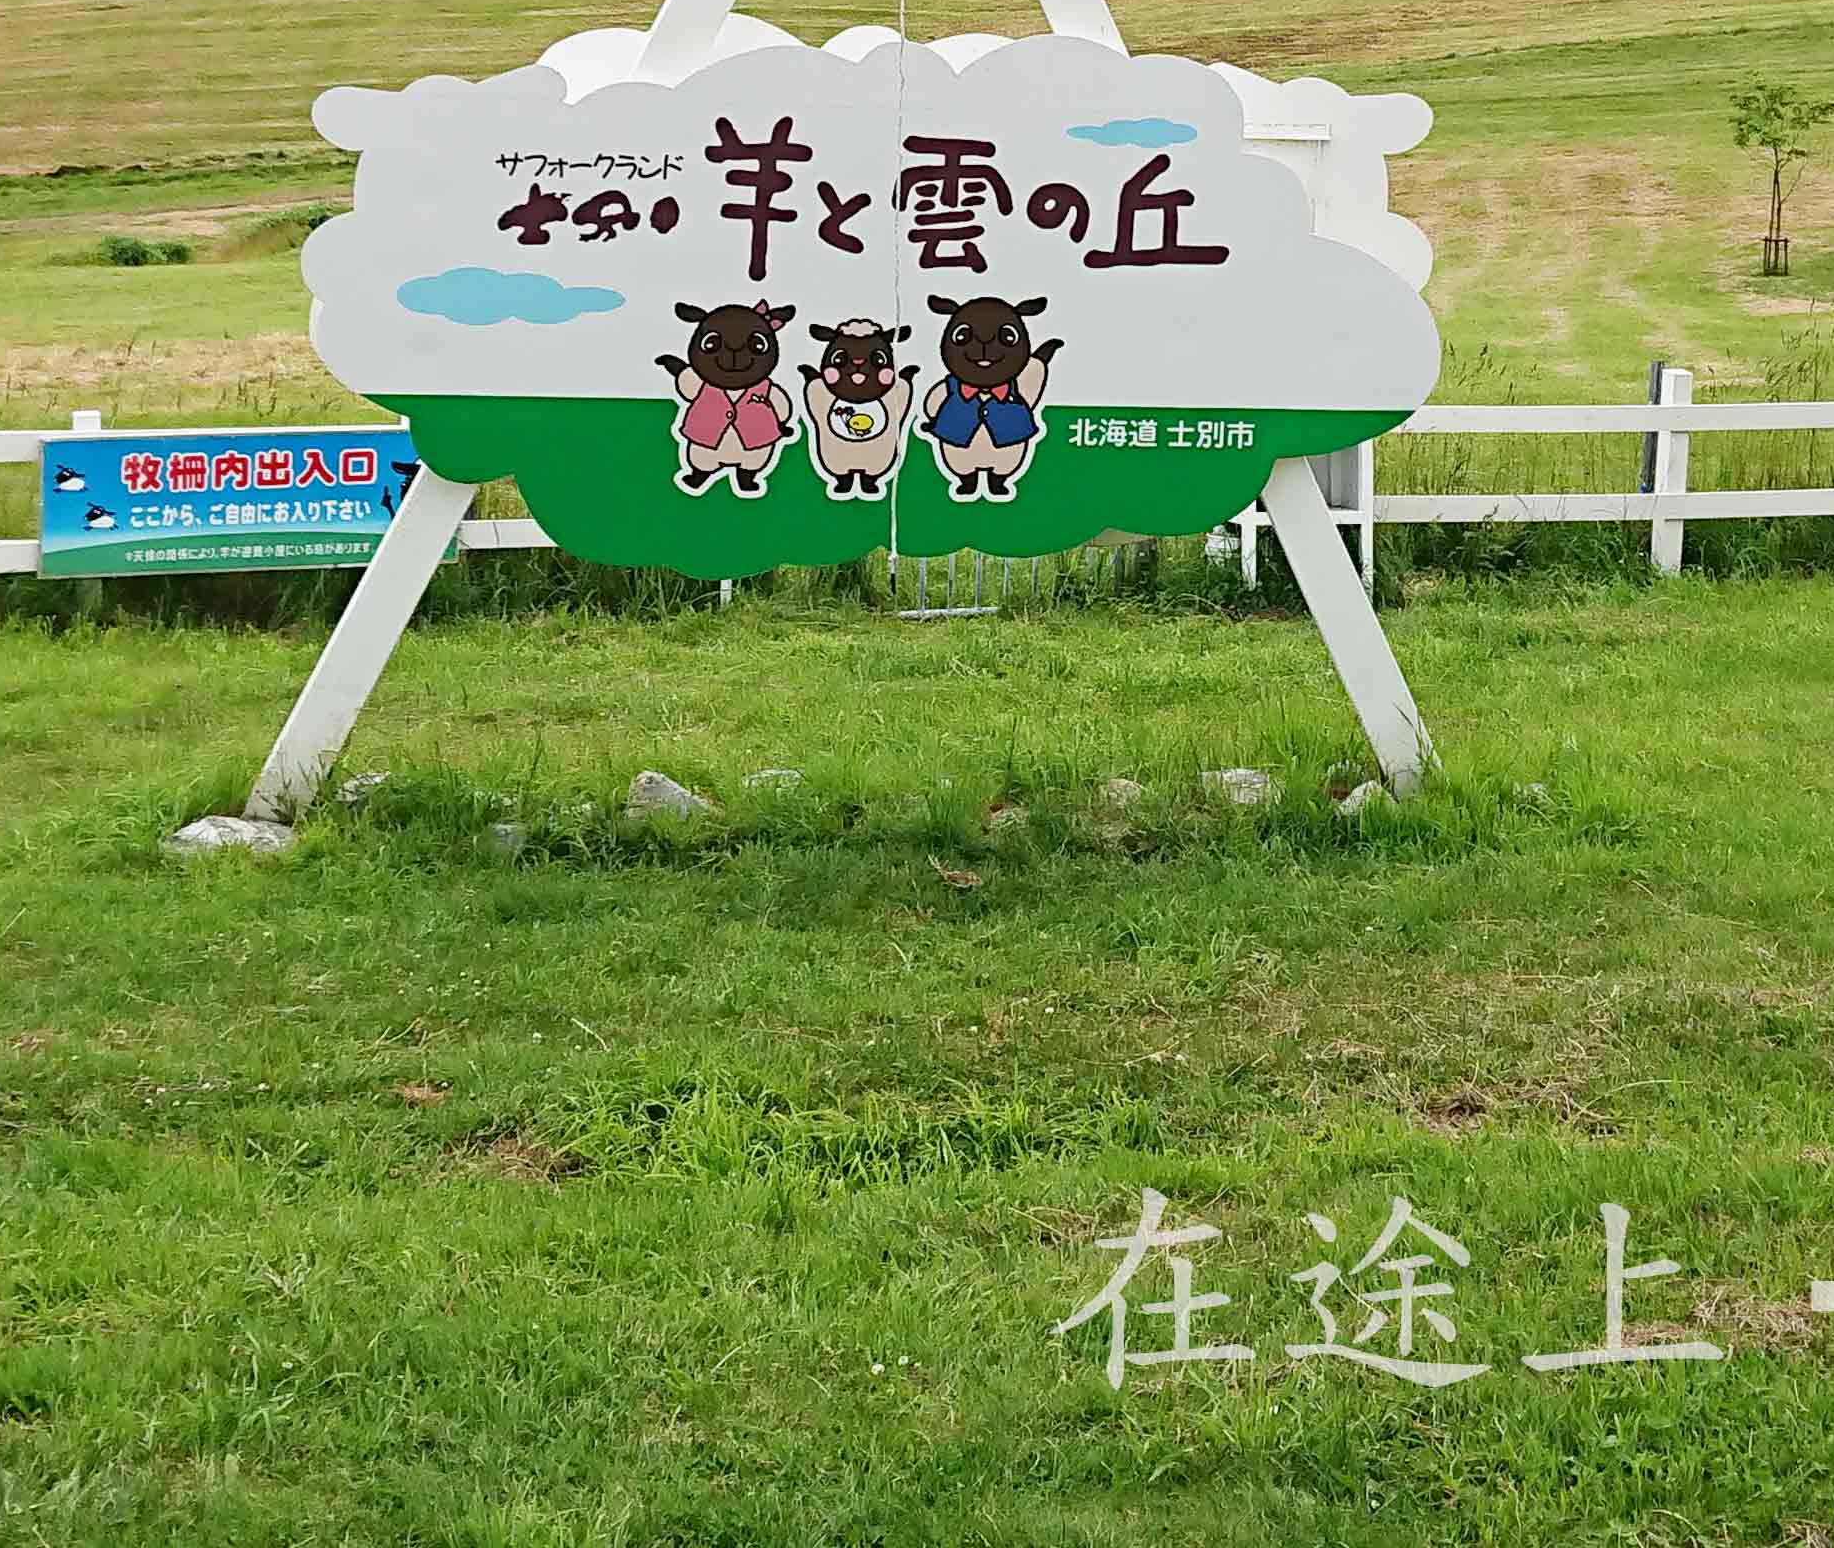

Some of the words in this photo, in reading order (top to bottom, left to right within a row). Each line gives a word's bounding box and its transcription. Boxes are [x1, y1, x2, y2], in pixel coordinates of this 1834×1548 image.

[496, 152, 683, 179] サフォークランド
[705, 116, 1230, 281] 羊と雲の丘
[1068, 418, 1158, 447] 北海道
[1167, 420, 1256, 449] 士別市
[122, 448, 379, 493] 牧柵内出入口
